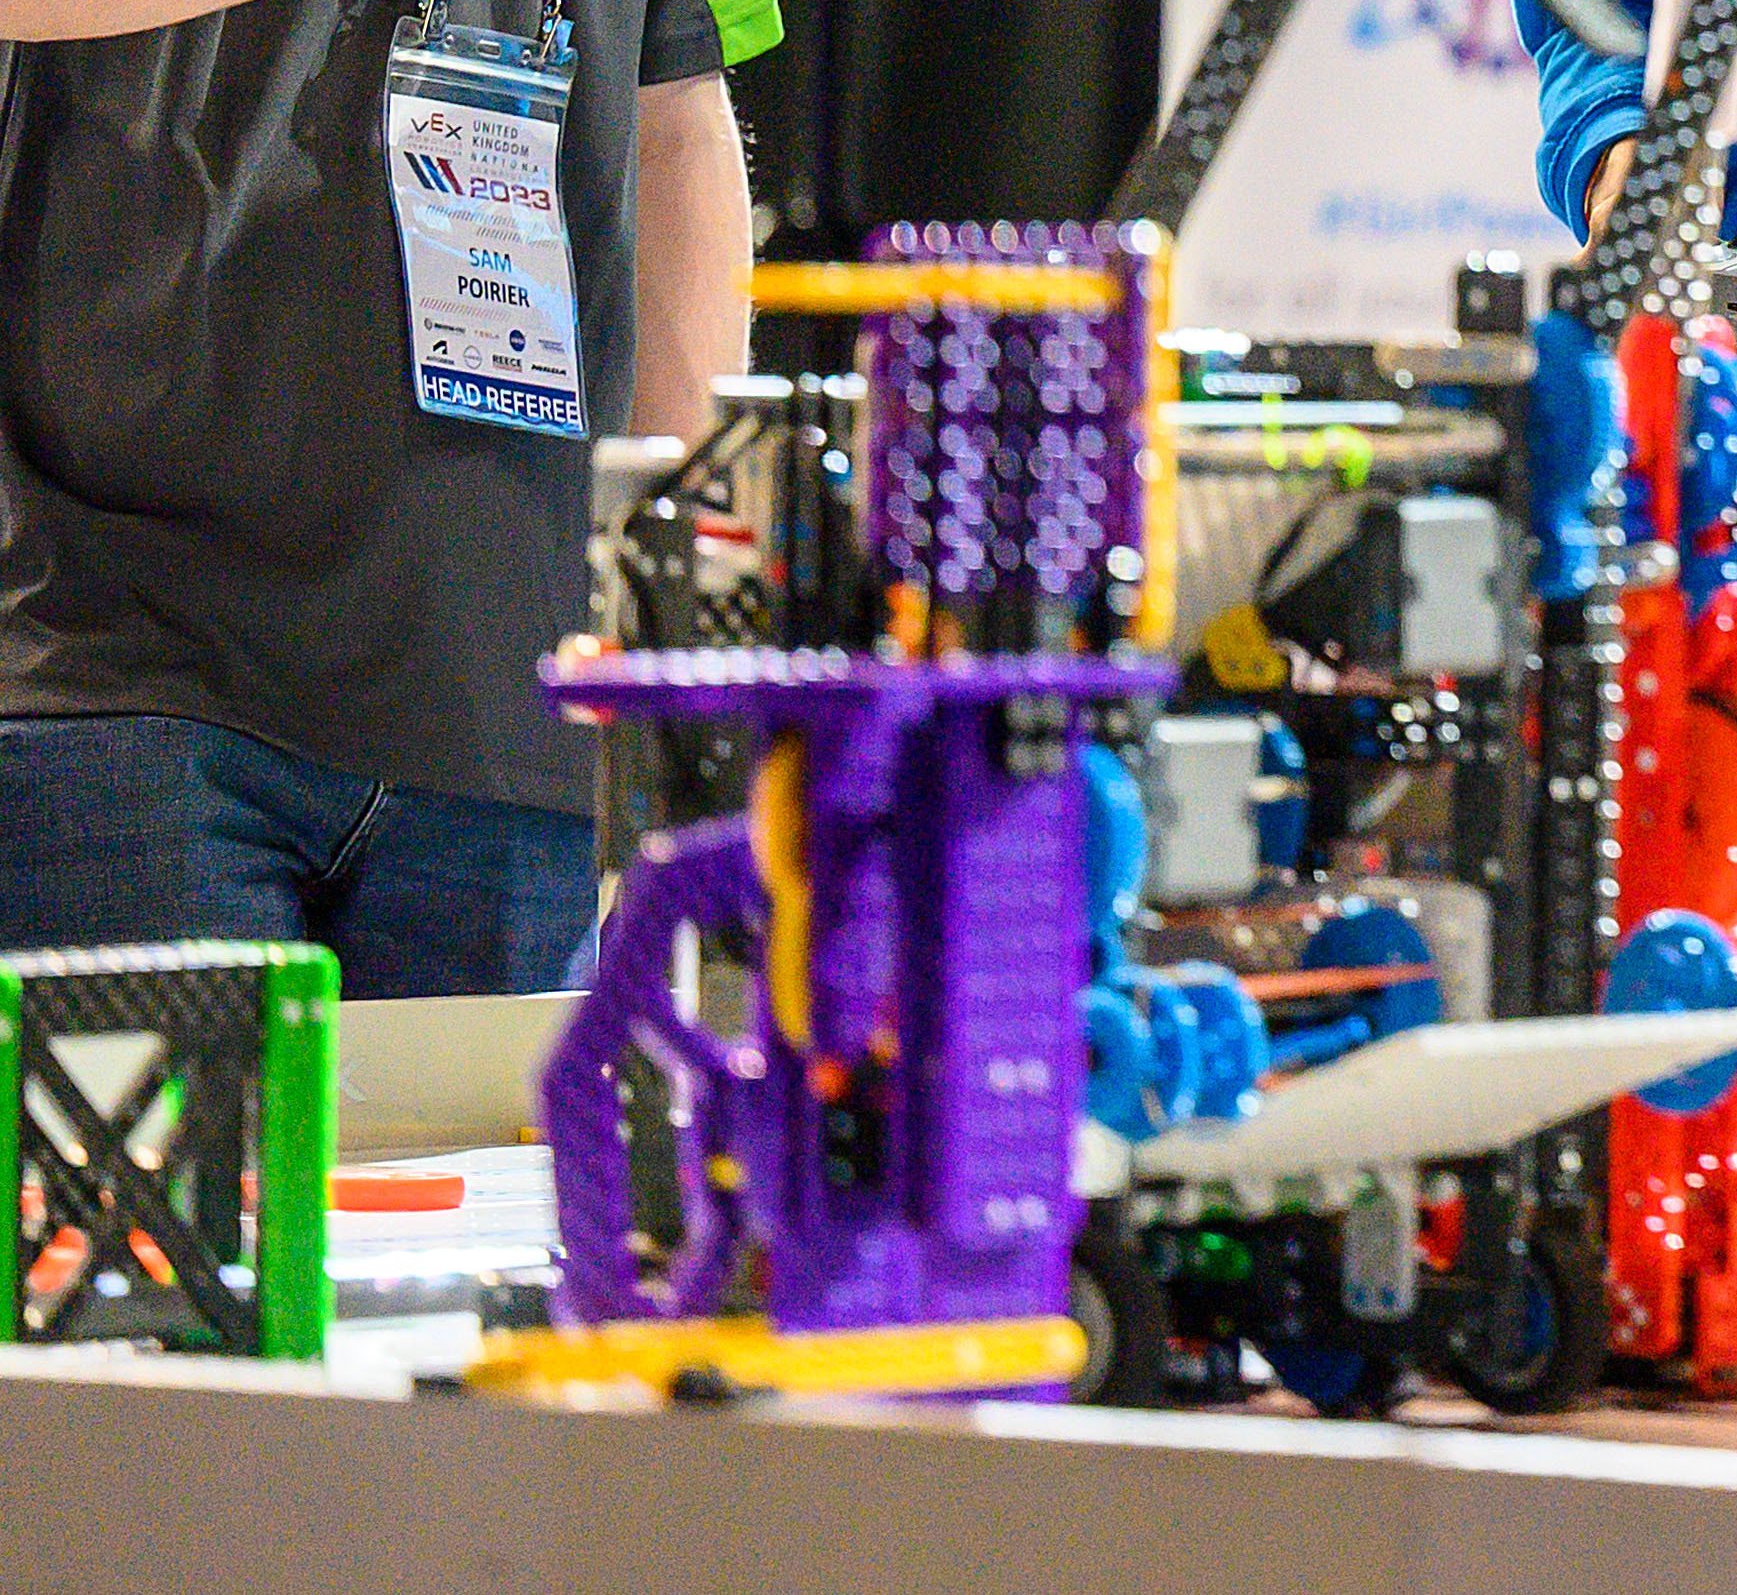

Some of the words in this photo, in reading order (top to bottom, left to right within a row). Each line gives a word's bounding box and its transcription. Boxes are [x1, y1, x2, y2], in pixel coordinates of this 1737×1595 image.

[411, 112, 463, 140] VEX
[473, 120, 519, 139] UNITED
[472, 136, 530, 157] KINGDOM
[470, 177, 551, 210] 2023
[469, 247, 513, 273] SAM
[457, 275, 530, 307] POIRIER
[492, 353, 523, 368] REECE
[423, 373, 481, 408] HEAD
[486, 384, 578, 425] REFEREE
